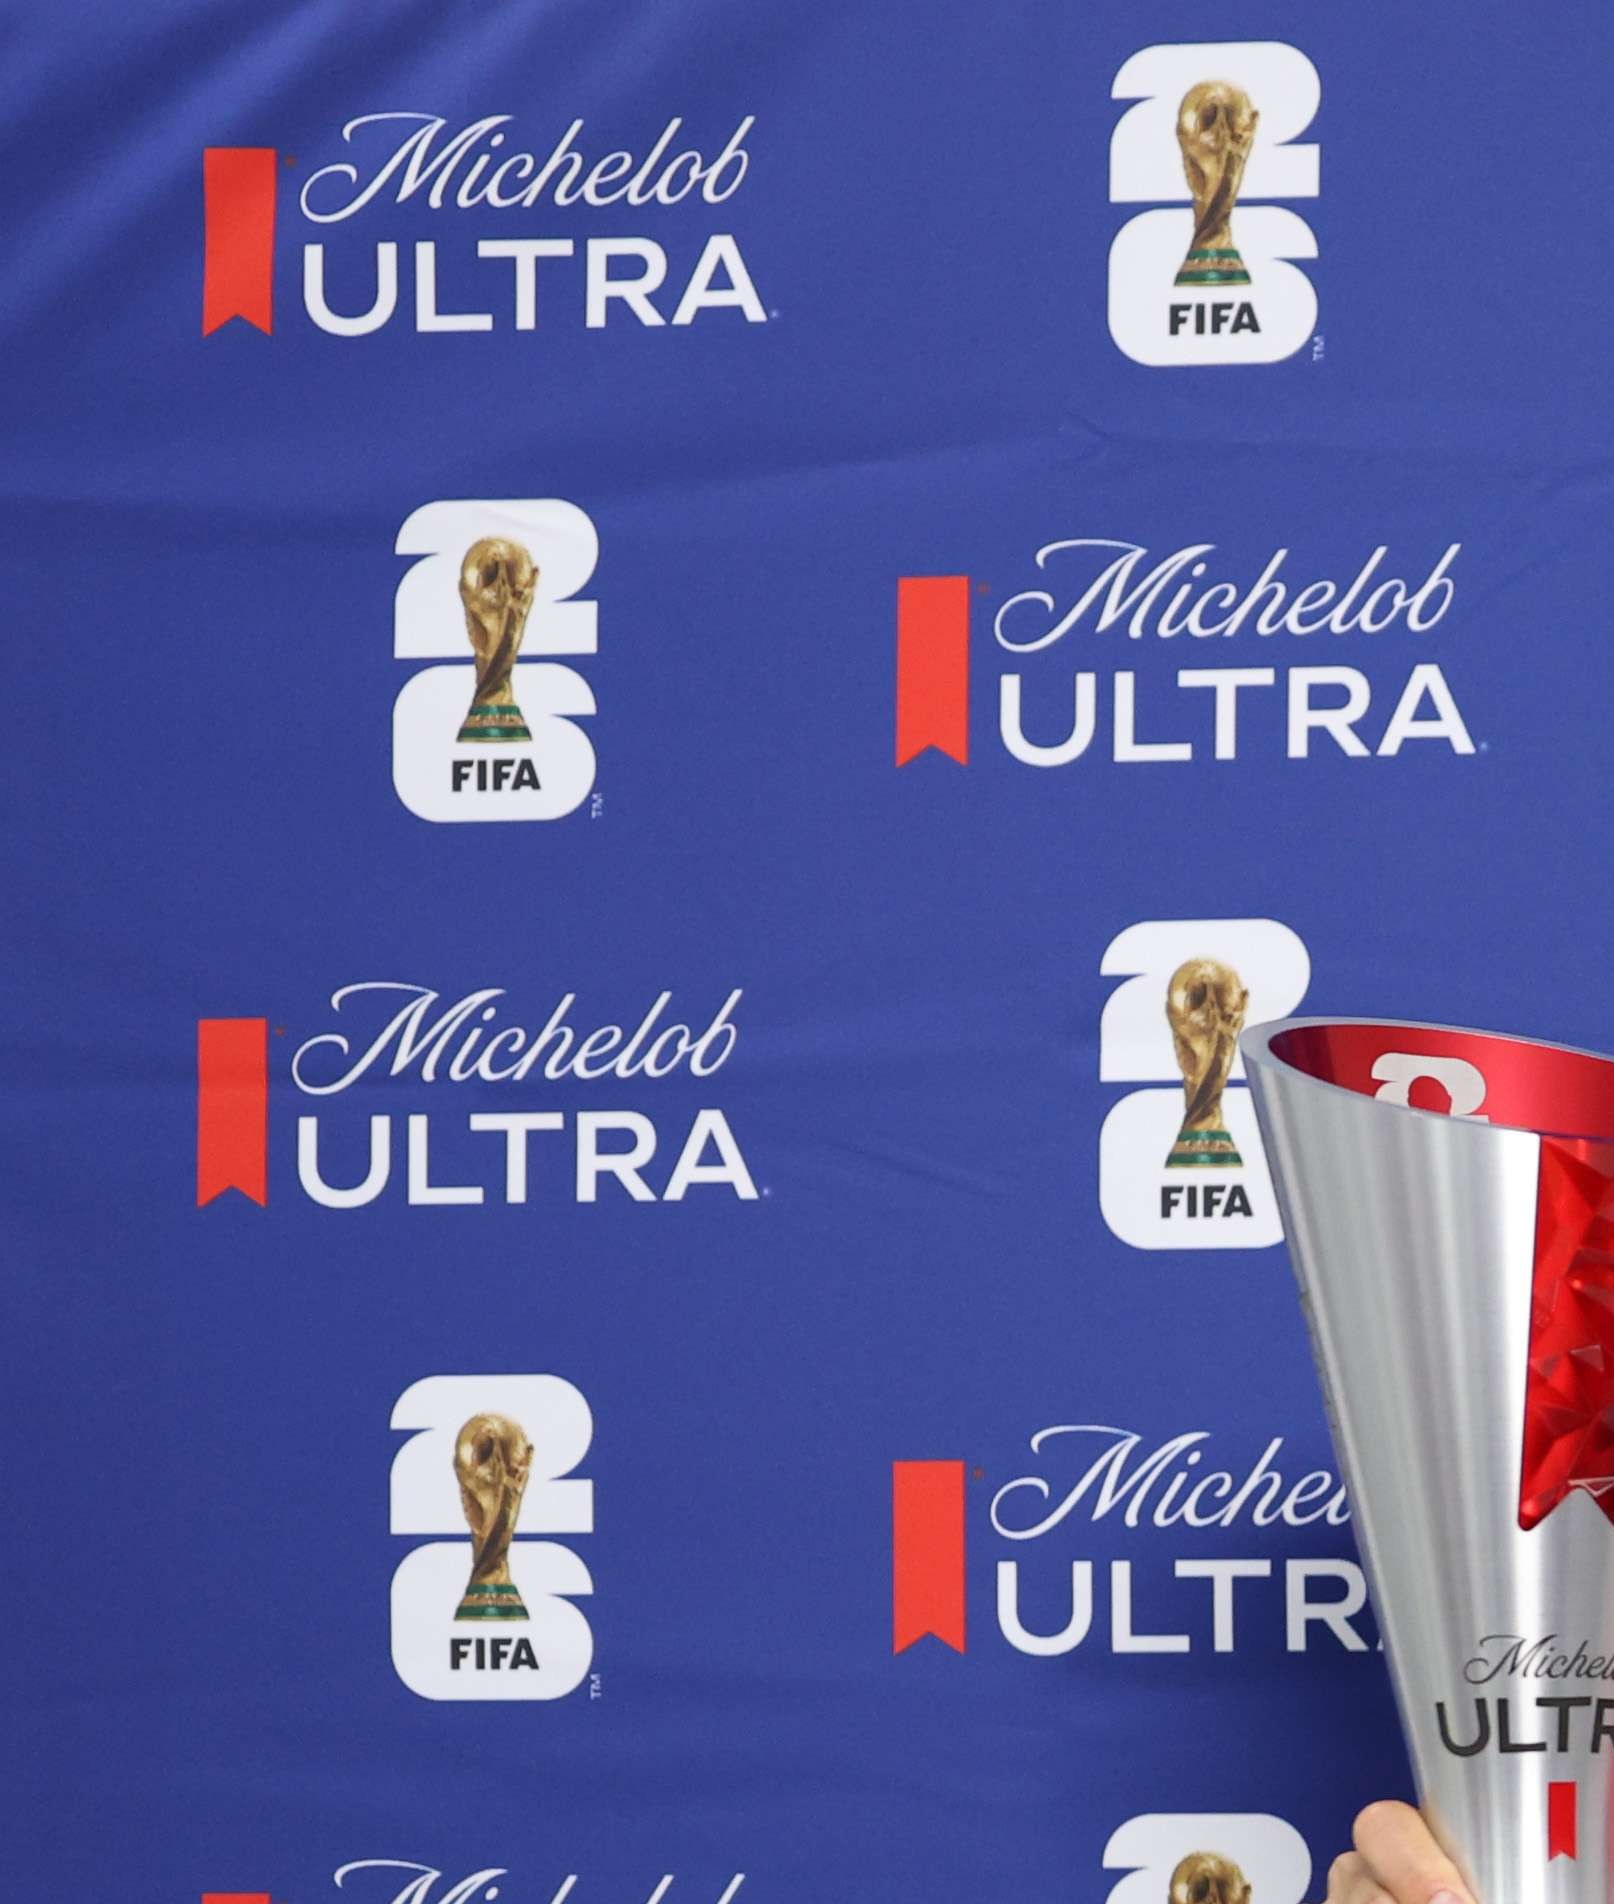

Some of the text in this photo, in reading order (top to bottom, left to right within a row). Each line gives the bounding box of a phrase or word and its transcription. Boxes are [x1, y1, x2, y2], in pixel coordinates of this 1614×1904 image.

[301, 113, 754, 222] Michelob
[304, 234, 767, 337] ULTRA
[1169, 302, 1261, 336] FIFA
[995, 539, 1460, 652] Michelob
[1001, 664, 1475, 767] ULTRA
[452, 758, 541, 793] FIFA
[292, 983, 742, 1095] Michelob
[299, 1110, 758, 1208] ULTRA
[1161, 1184, 1253, 1219] FIFA
[990, 1425, 1353, 1540] Miche
[450, 1637, 540, 1671] FIFA
[997, 1559, 1385, 1656] ULTR
